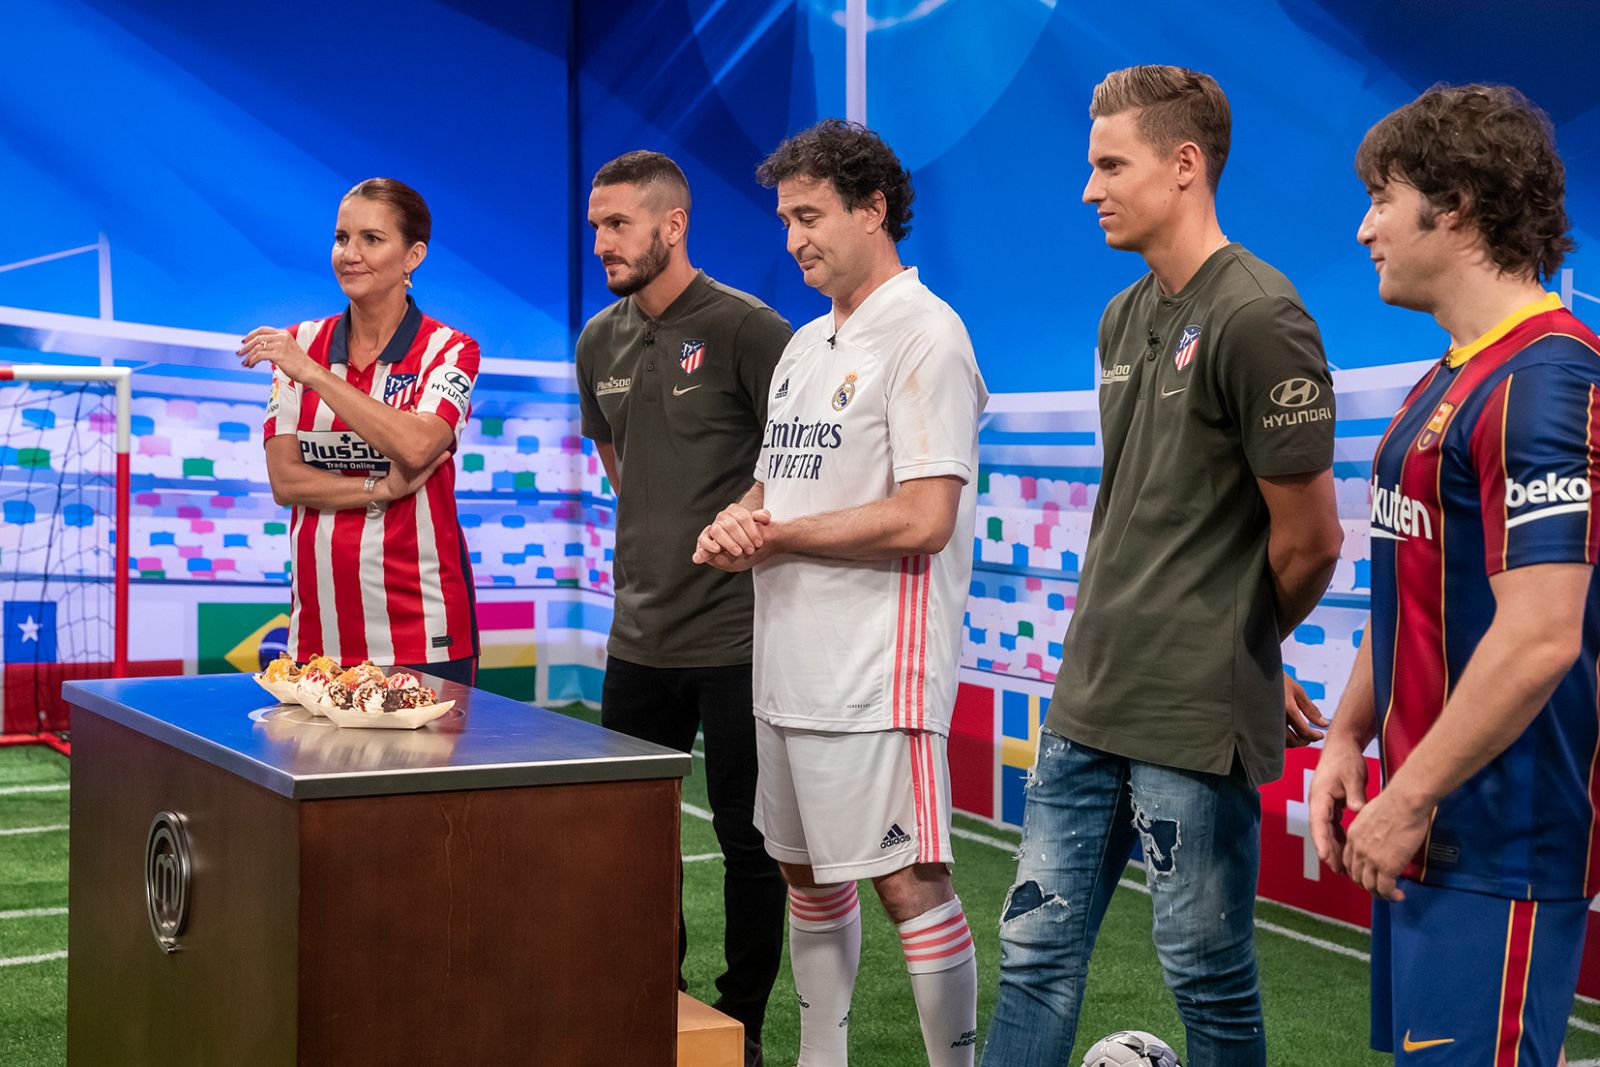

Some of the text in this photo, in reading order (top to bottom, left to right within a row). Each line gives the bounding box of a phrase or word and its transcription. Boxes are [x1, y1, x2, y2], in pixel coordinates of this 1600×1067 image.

[1262, 407, 1332, 429] HYUNDAI
[762, 416, 842, 449] Emirates
[299, 440, 385, 460] Plus50
[326, 462, 376, 470] Trade Online
[781, 453, 823, 481] BETER
[1505, 473, 1592, 509] beko
[1370, 474, 1433, 541] kuten
[880, 834, 911, 849] adidas
